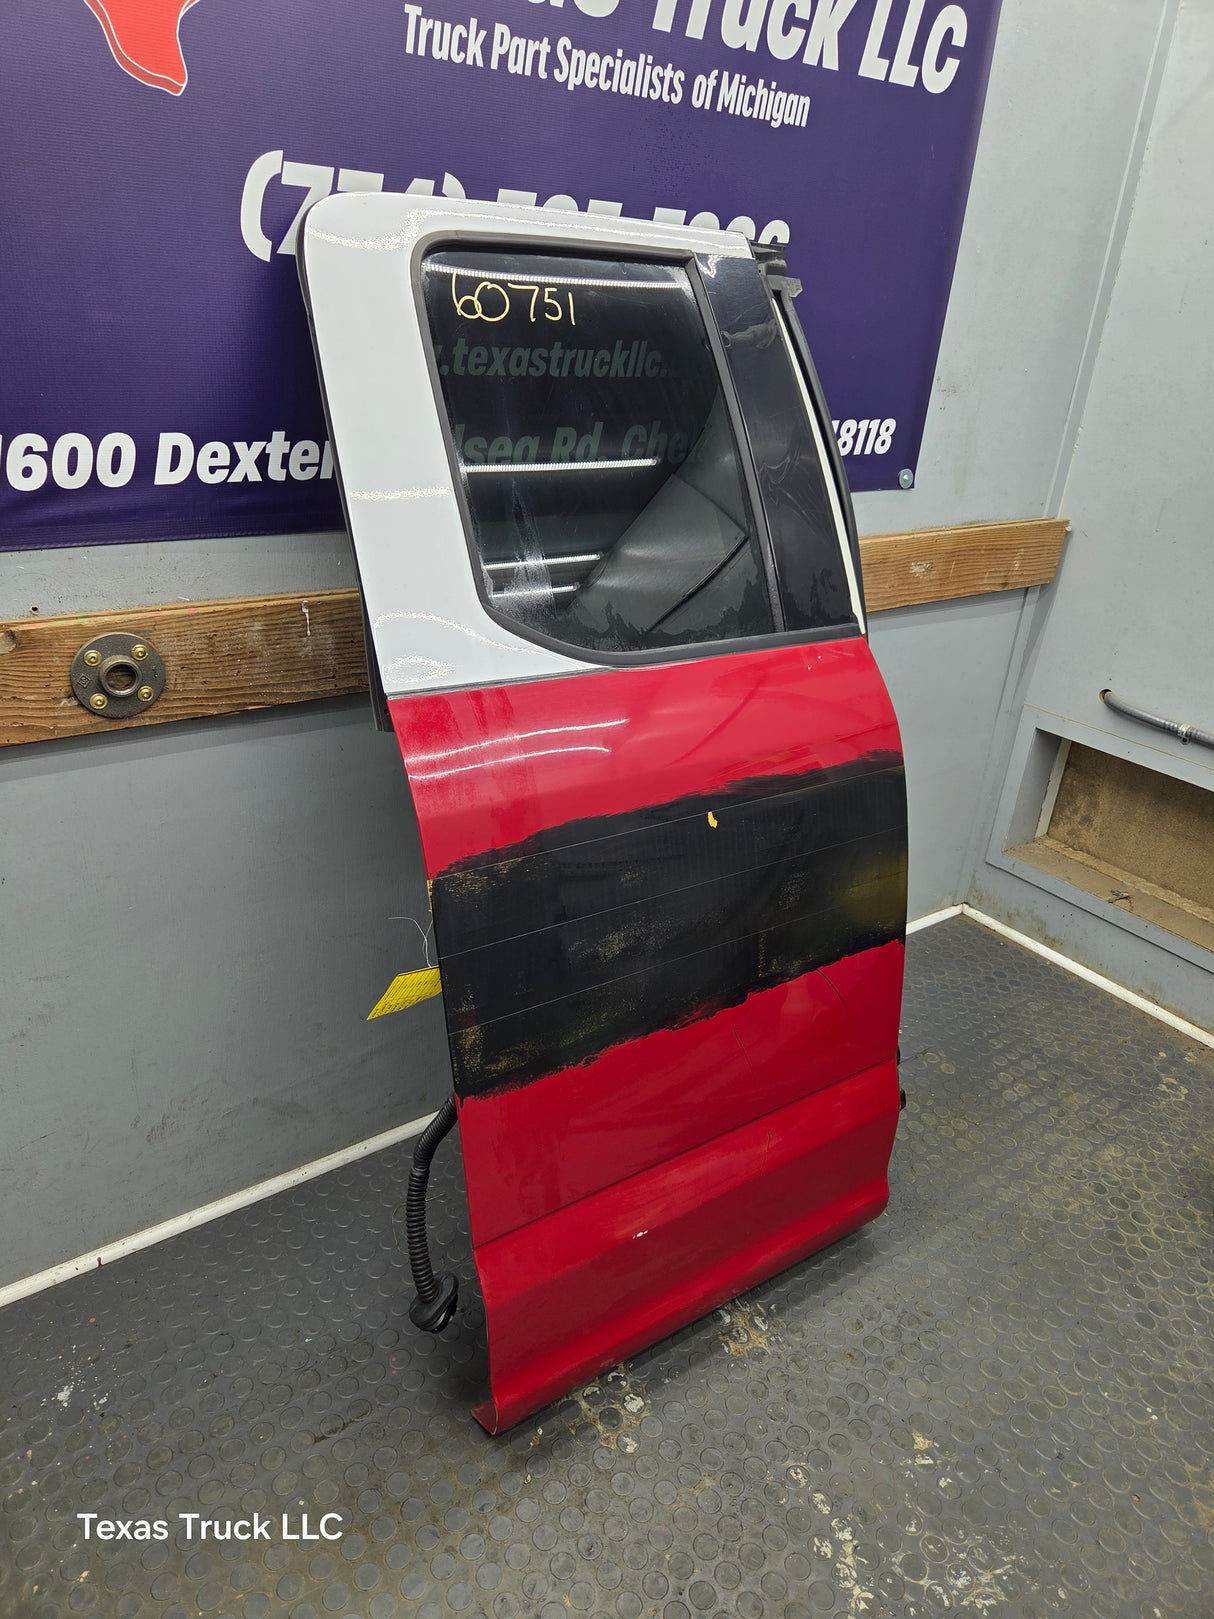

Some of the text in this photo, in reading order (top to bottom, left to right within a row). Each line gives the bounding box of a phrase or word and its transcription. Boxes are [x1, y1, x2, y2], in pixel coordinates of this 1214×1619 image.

[404, 3, 811, 128] Truck Part Specialists of Michigan
[451, 268, 576, 326] 60751
[0, 432, 137, 492] 600
